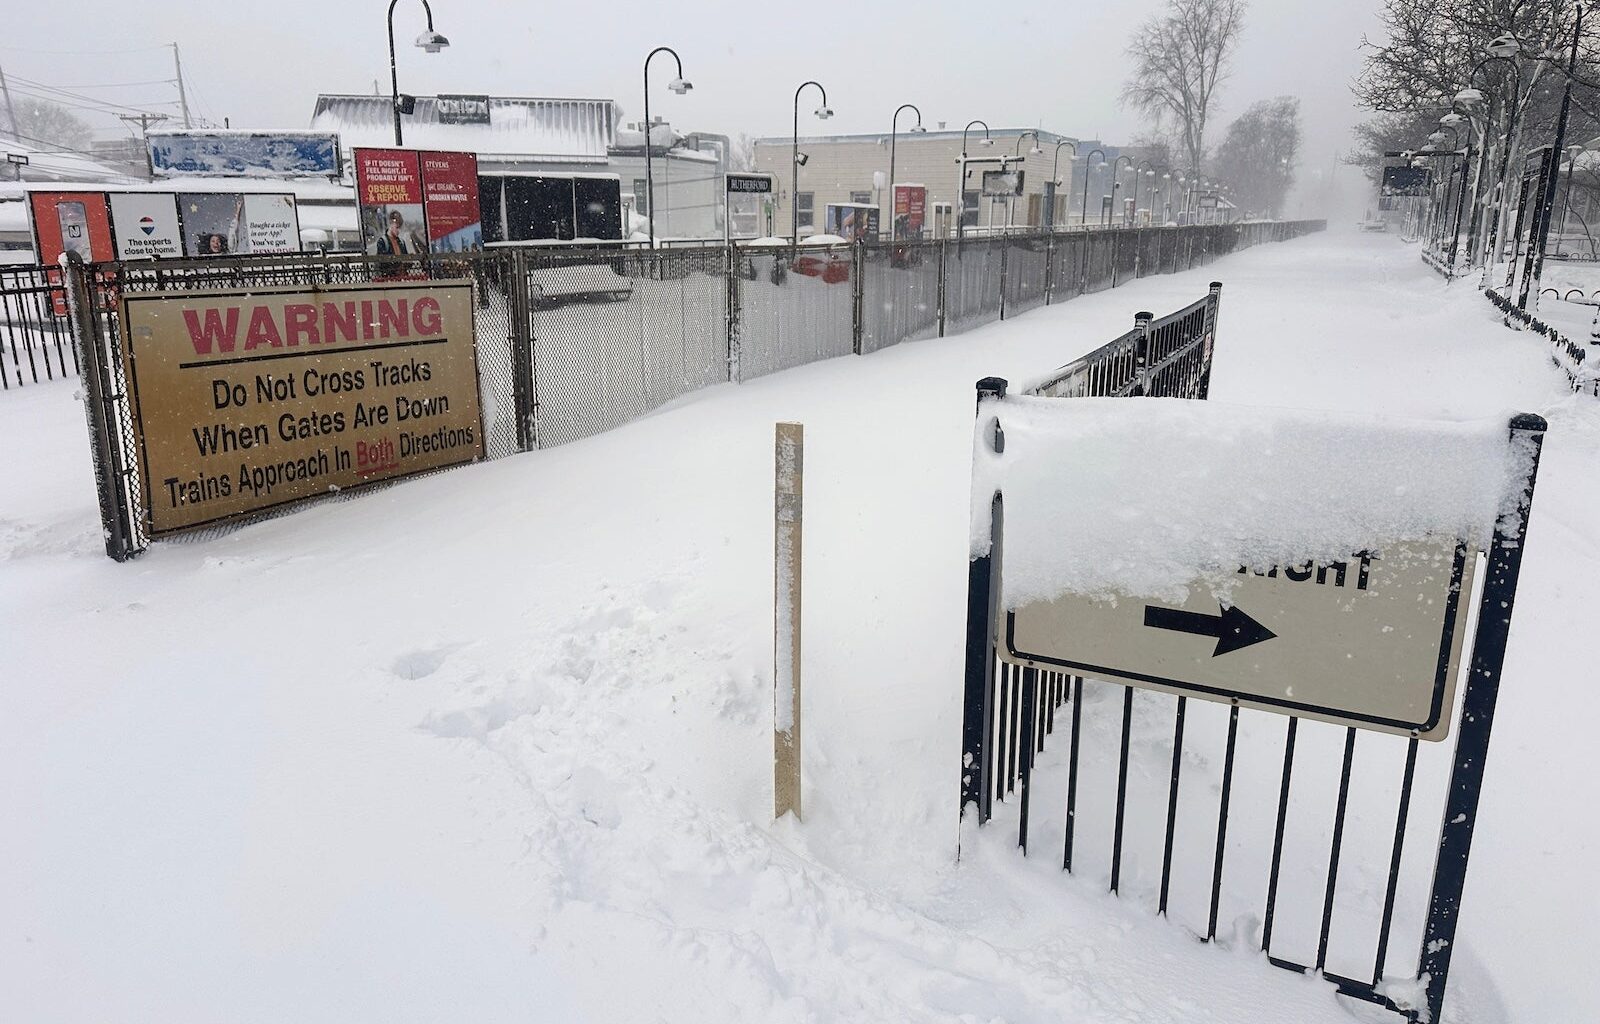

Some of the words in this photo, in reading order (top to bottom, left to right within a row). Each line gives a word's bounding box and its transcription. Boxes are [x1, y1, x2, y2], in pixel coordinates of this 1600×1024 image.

[437, 98, 489, 114] UNION
[426, 160, 449, 168] STEVENS
[368, 184, 406, 193] OBSERVE
[730, 178, 769, 190] RUTHERFORD
[368, 193, 376, 202] &
[376, 193, 410, 202] REPORT.
[250, 221, 270, 230] Bought
[276, 221, 291, 229] ticket
[269, 230, 283, 238] App?
[144, 238, 172, 247] experts
[182, 296, 443, 355] WARNING
[212, 379, 247, 410] Do
[255, 372, 297, 404] Not
[303, 367, 365, 397] Cross
[370, 358, 432, 388] Tracks
[193, 423, 270, 457] When
[278, 410, 346, 443] Gates
[353, 402, 389, 430] Are
[395, 393, 449, 422] Down
[164, 474, 232, 508] Trains
[238, 449, 329, 497] Approach
[335, 446, 351, 471] In
[356, 438, 395, 467] Both
[399, 426, 475, 458] Directions
[1237, 549, 1381, 590] GHT
